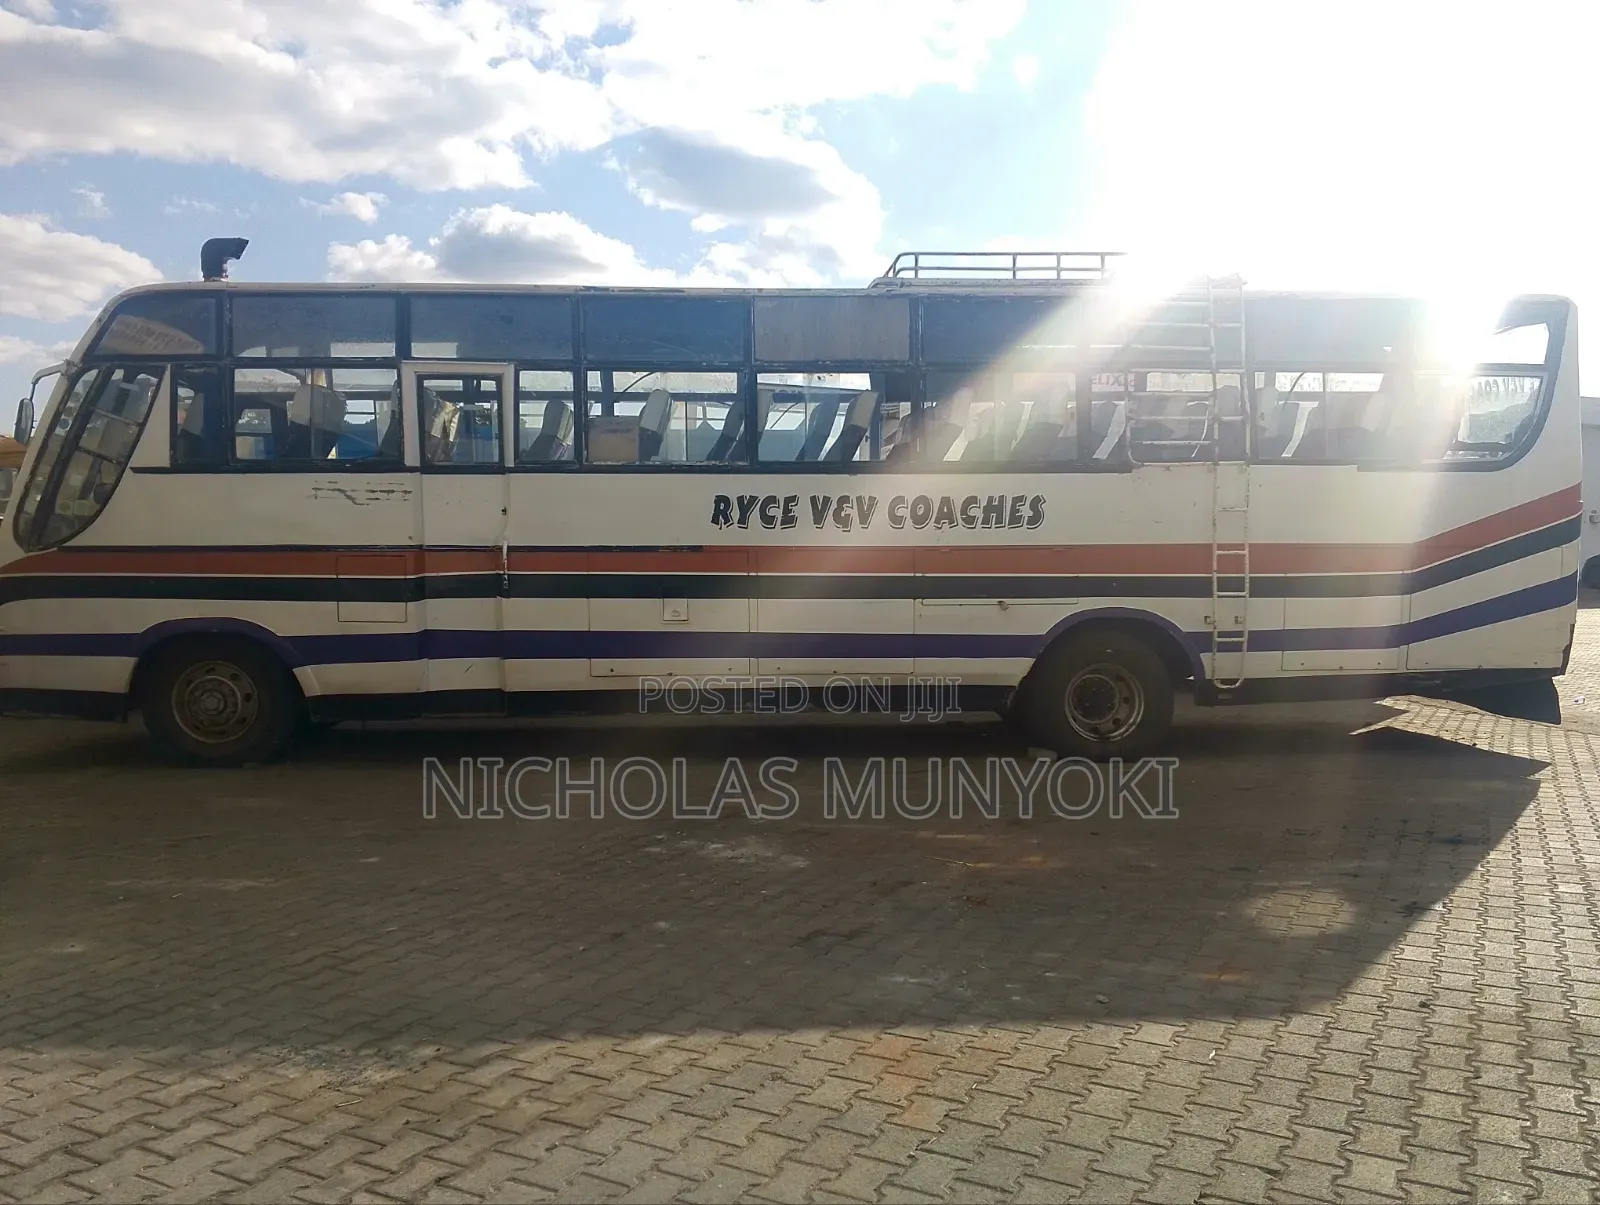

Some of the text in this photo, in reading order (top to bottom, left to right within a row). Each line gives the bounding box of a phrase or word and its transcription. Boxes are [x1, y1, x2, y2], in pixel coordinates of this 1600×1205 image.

[710, 494, 1047, 532] RYCE V&V COACHES
